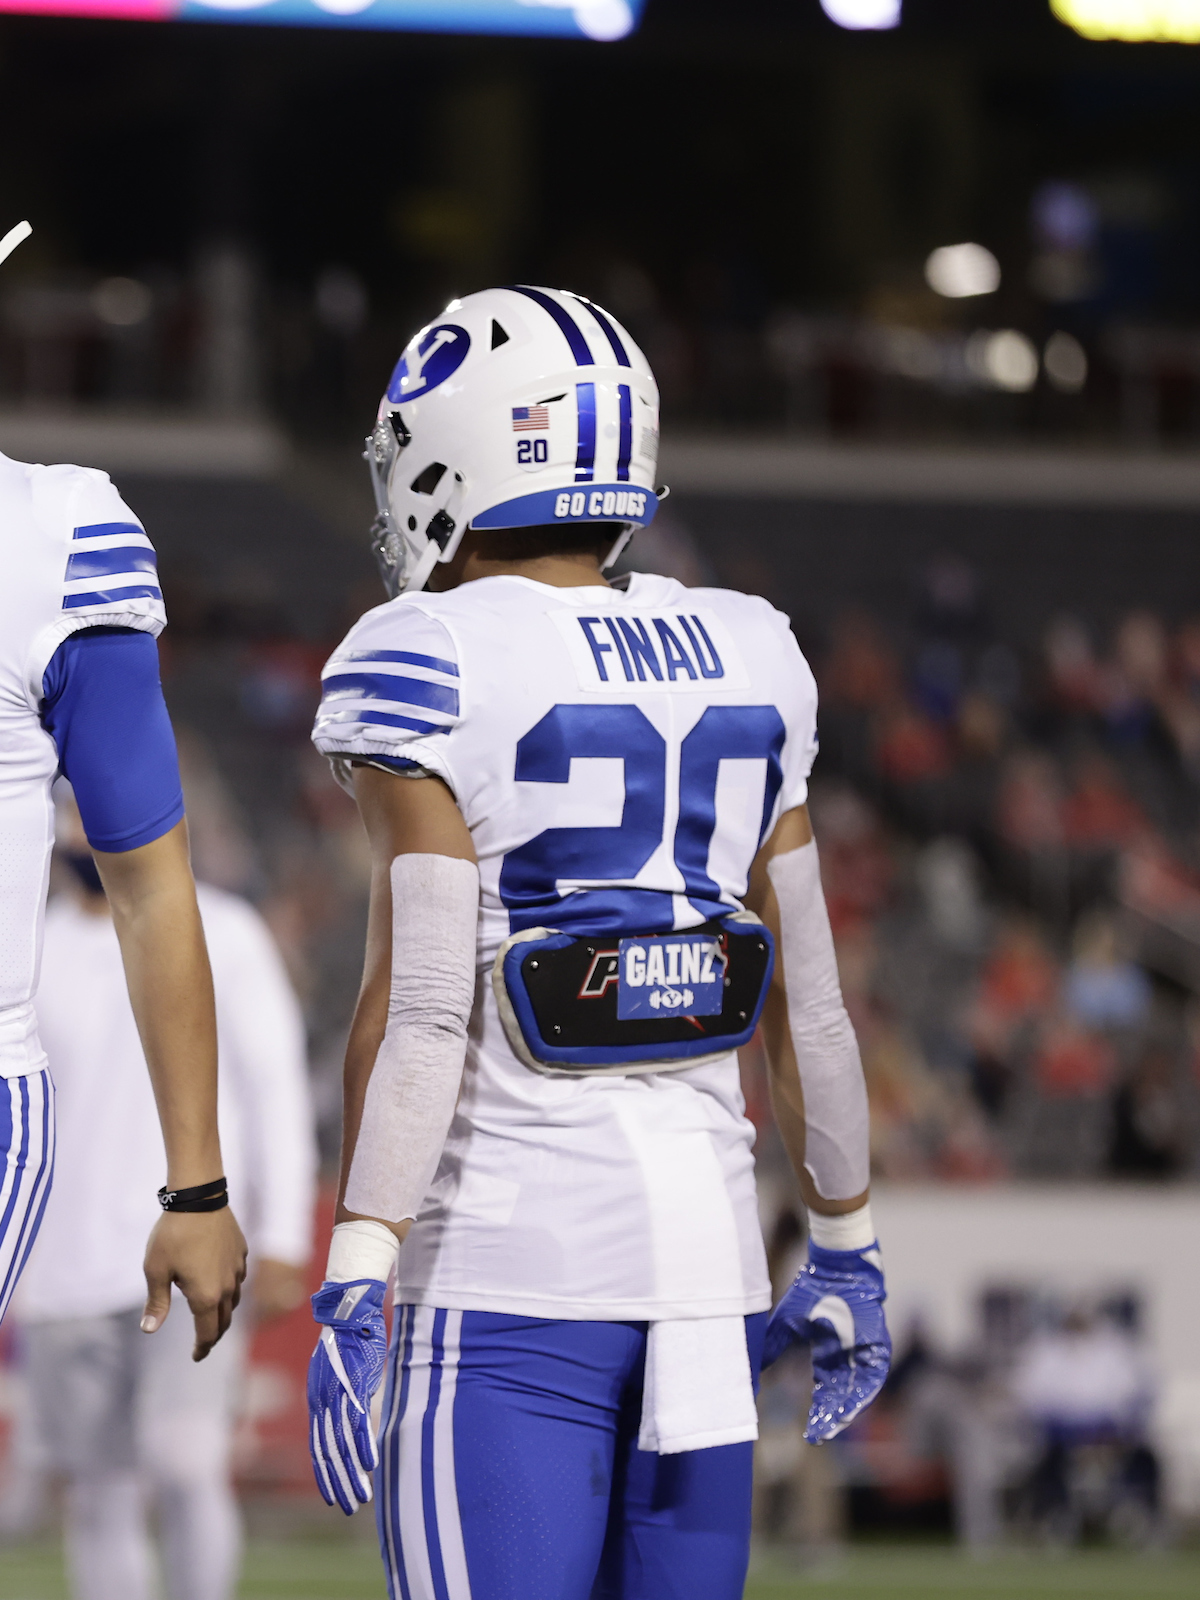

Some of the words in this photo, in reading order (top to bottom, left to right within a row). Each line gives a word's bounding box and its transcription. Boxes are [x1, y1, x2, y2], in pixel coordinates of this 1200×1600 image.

[400, 327, 459, 396] Y
[517, 438, 548, 464] 20
[554, 492, 586, 518] GO
[588, 490, 647, 518] COUGS
[577, 615, 725, 682] FINAU
[499, 704, 787, 936] 20
[625, 942, 717, 988] GAINZ
